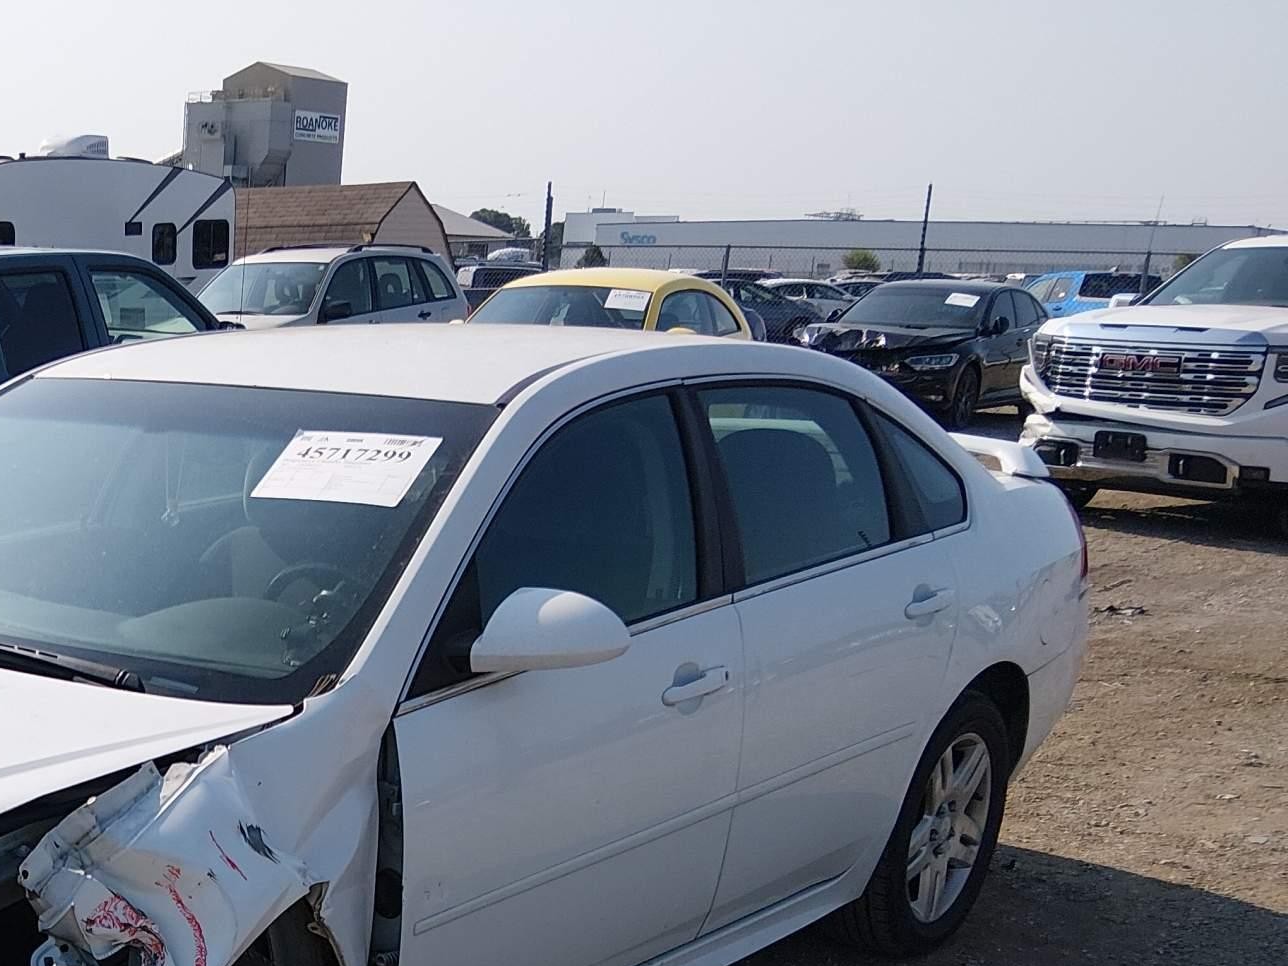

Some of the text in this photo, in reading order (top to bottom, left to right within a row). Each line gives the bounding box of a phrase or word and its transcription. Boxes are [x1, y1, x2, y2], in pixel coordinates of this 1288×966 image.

[296, 115, 339, 132] ROANOKE
[1102, 354, 1180, 373] GMC
[297, 446, 412, 464] 45717299
